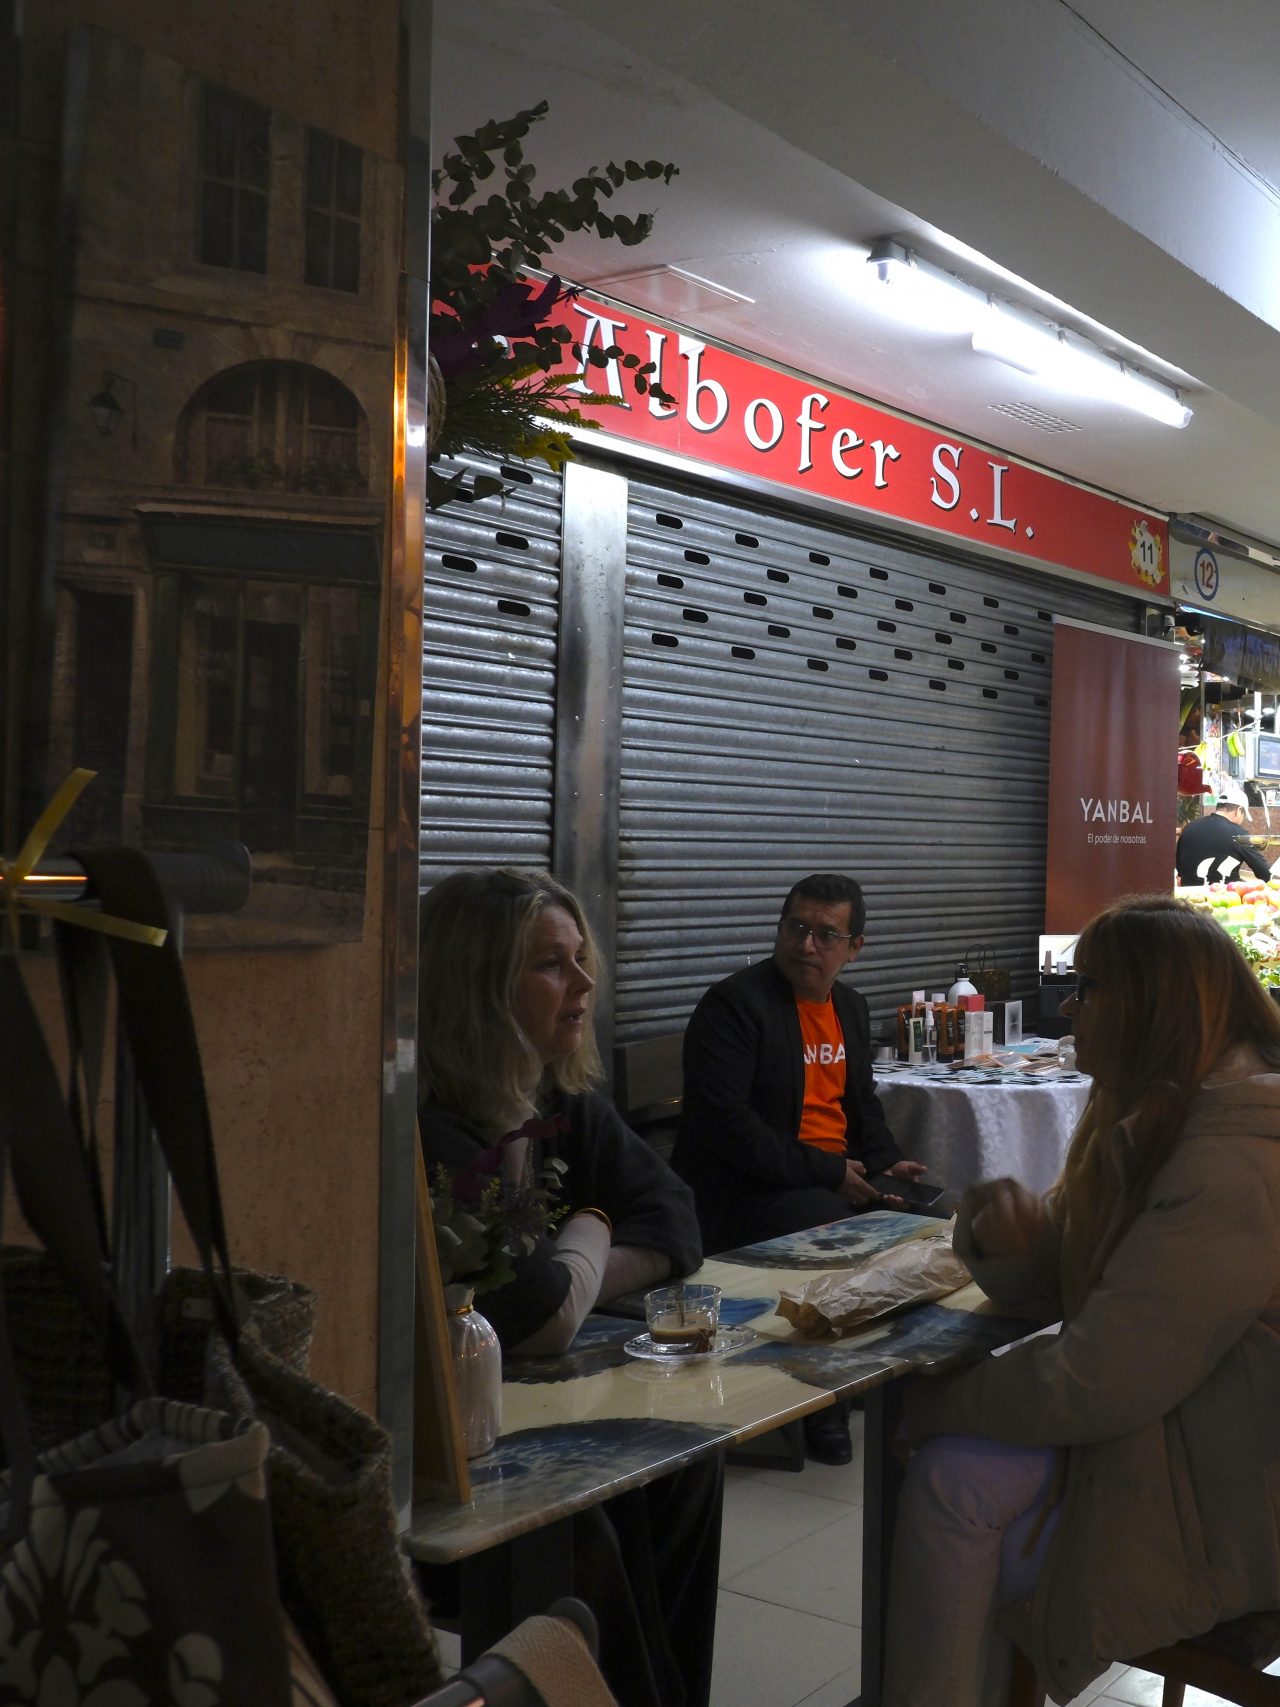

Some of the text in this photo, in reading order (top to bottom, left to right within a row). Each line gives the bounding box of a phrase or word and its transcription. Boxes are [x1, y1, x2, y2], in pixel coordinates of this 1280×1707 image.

[566, 303, 1034, 539] Albofer S.L.
[1140, 540, 1154, 565] 11
[1199, 559, 1214, 590] 12
[1080, 797, 1154, 824] YANBAL
[1087, 833, 1147, 846] El poder de nosotras
